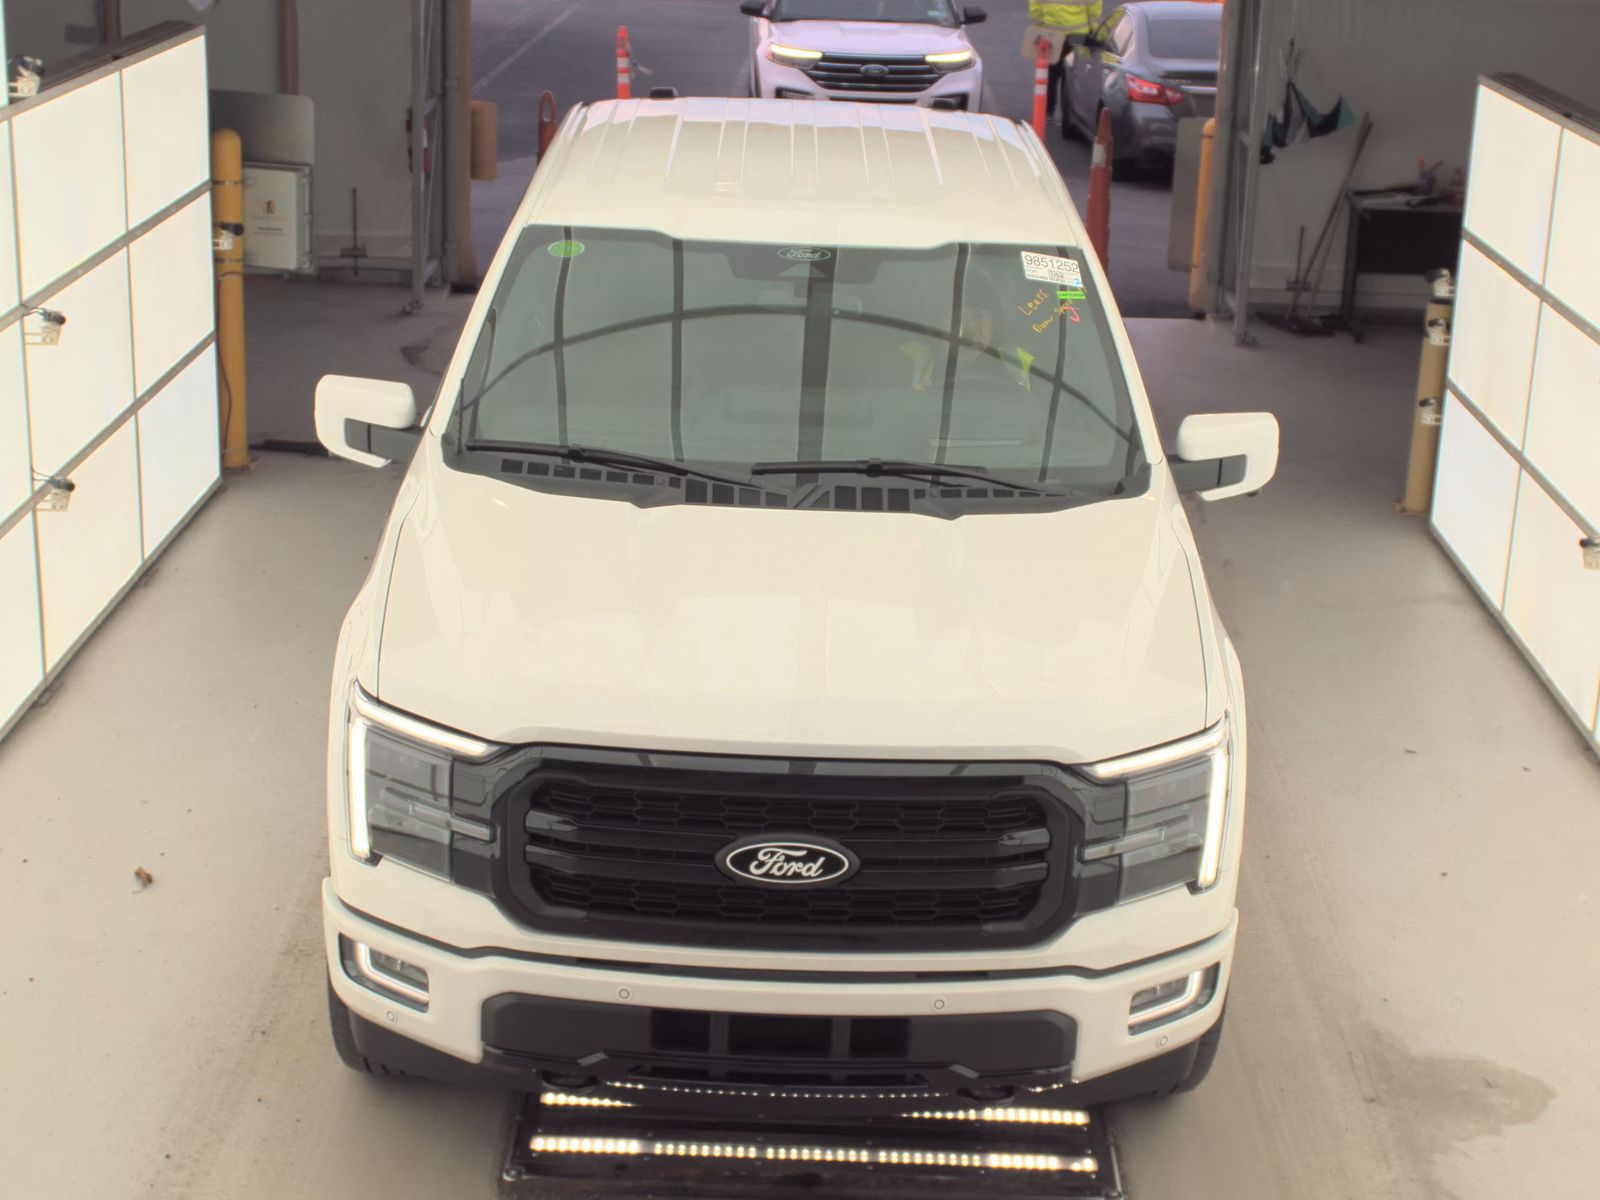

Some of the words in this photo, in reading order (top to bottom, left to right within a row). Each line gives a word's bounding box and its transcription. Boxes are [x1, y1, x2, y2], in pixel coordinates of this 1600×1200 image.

[786, 248, 822, 259] Ford
[1024, 254, 1079, 273] 9851252
[749, 847, 826, 877] Ford
